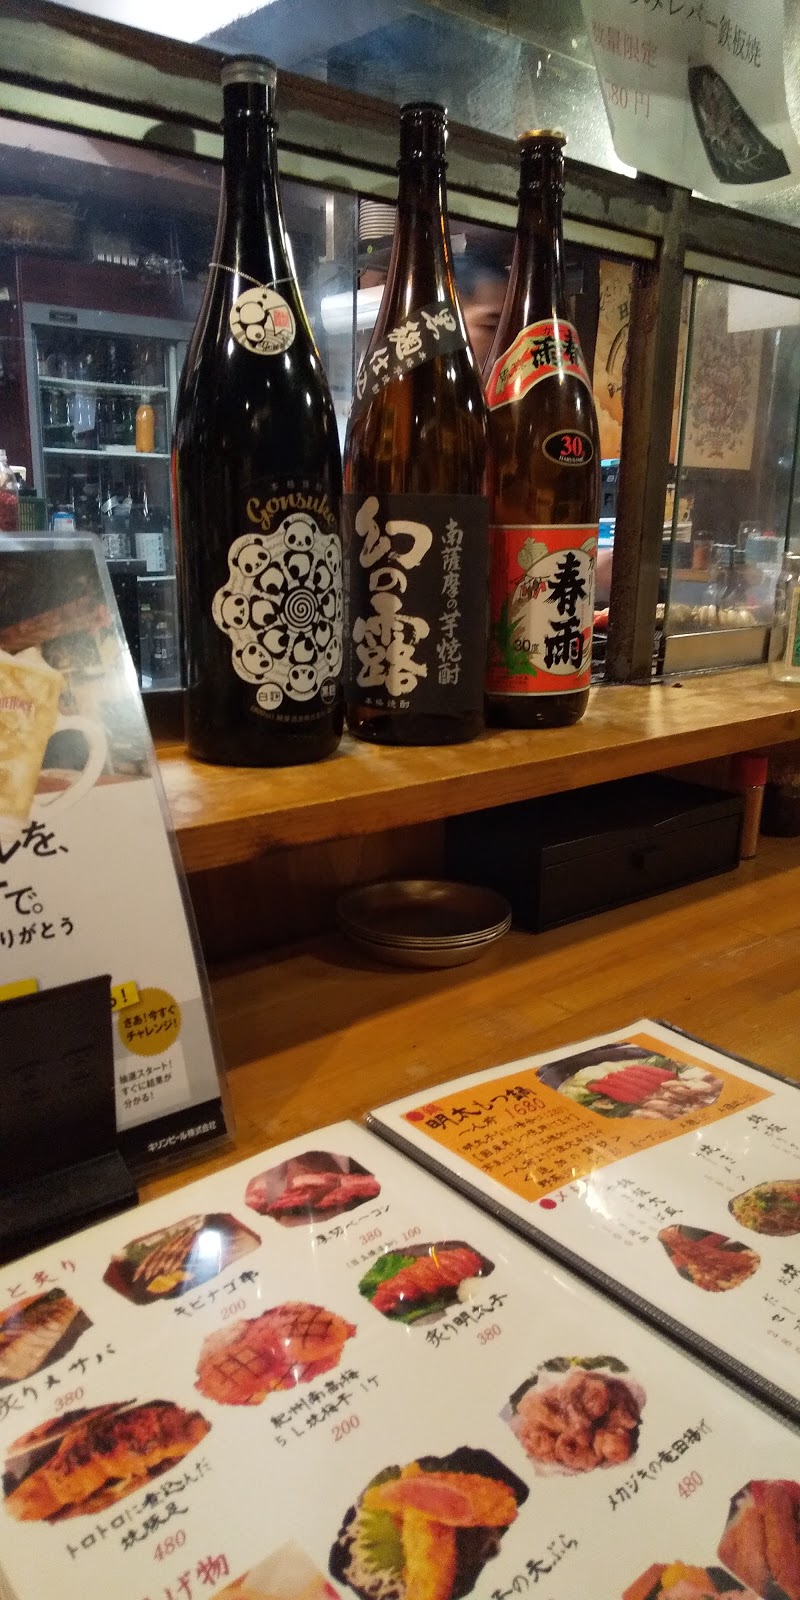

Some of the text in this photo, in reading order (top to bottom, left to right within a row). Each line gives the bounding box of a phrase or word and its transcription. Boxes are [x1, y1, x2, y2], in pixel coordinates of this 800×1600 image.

[560, 435, 584, 457] 30
[246, 491, 337, 532] Gonsuke
[352, 496, 433, 697] 幻の露
[436, 518, 464, 686] 南薩摩の芋焼酎
[543, 551, 588, 670] 春雨
[514, 638, 541, 653] 30度
[505, 1097, 546, 1120] 1680
[147, 1119, 217, 1153] キリンビール株式会社
[359, 1228, 383, 1245] 380
[402, 1226, 421, 1242] 100
[173, 1269, 260, 1317] キビナゴ串
[220, 1300, 247, 1321] 200
[425, 1292, 508, 1349] 炙り明太子
[477, 1323, 502, 1346] 380
[54, 1386, 85, 1413] 380
[330, 1413, 361, 1443] 200
[677, 1469, 704, 1499] 480
[152, 1528, 188, 1563] 480
[142, 1553, 231, 1600] げ物
